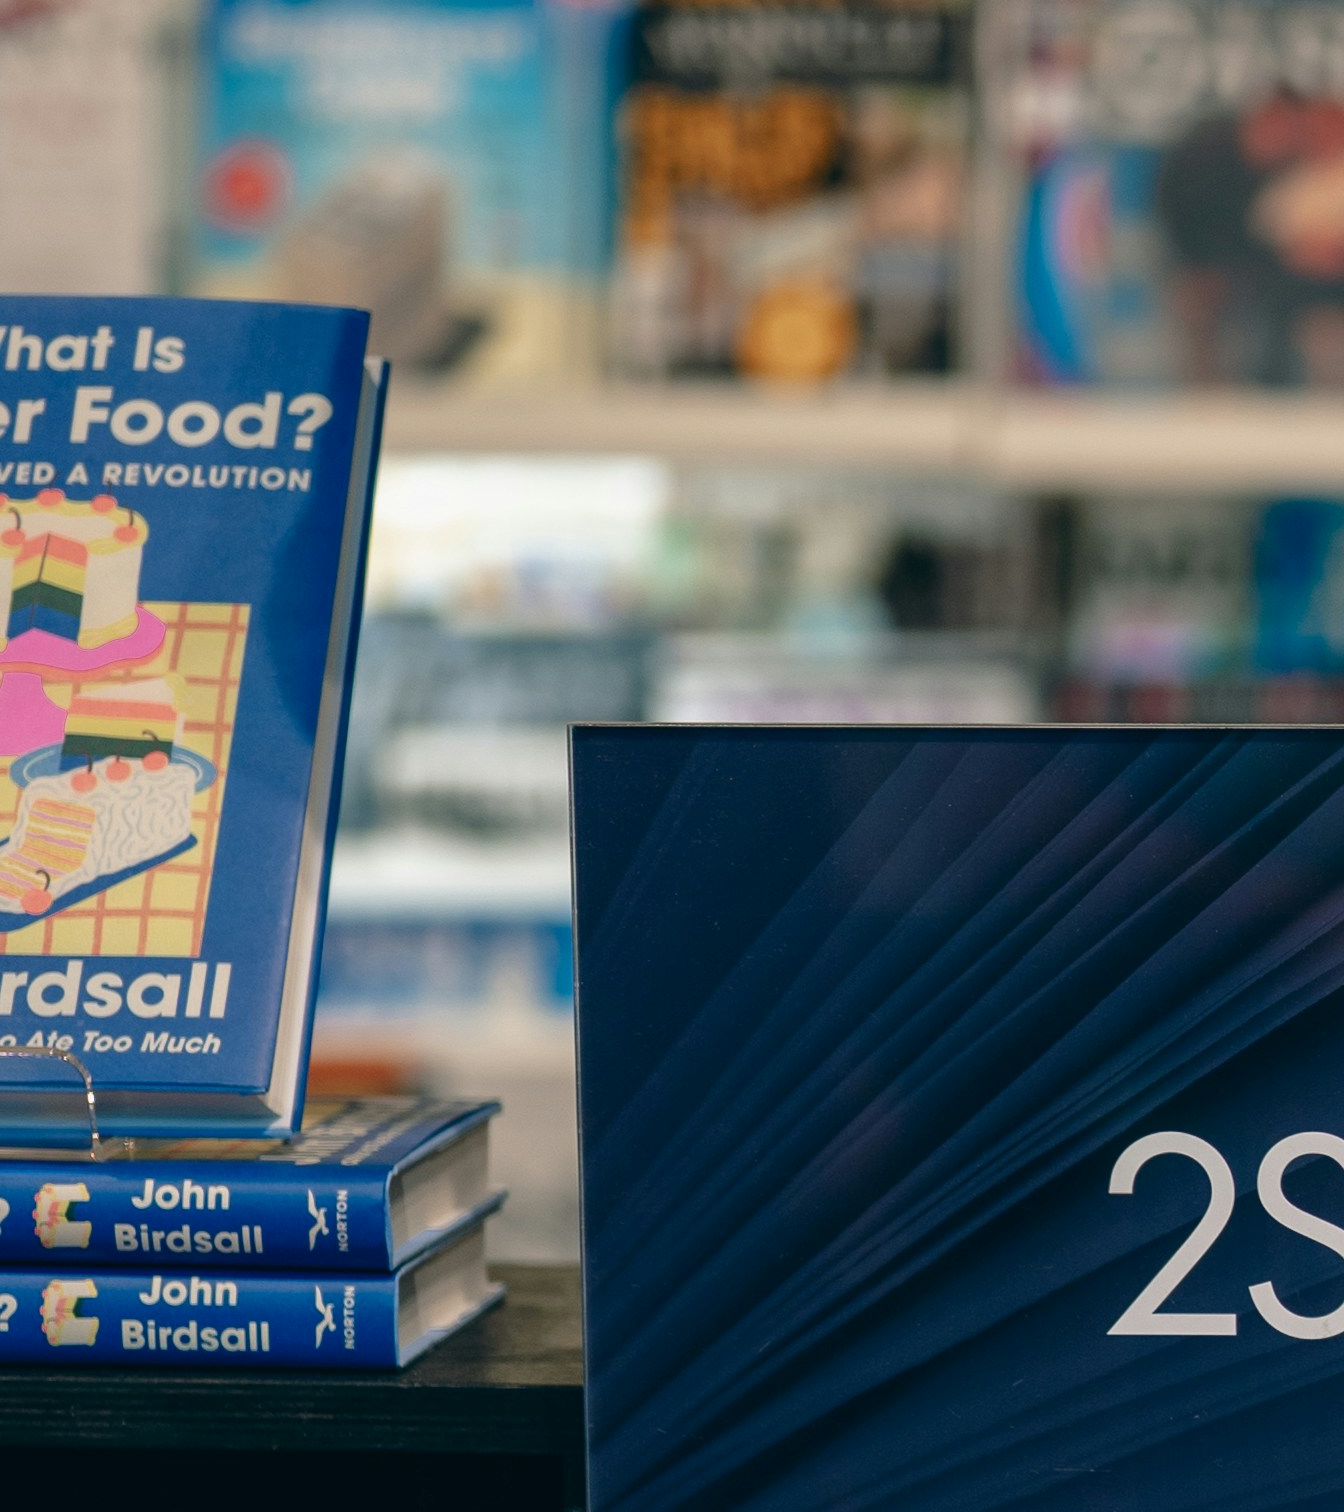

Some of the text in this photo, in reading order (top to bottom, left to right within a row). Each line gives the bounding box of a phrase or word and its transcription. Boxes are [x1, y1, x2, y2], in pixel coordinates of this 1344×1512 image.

[0, 325, 186, 373] hat Is
[69, 385, 333, 451] Food?
[66, 462, 312, 491] A REVOLUTION
[83, 1030, 133, 1053] Too
[141, 1031, 222, 1055] Much
[131, 1179, 231, 1210] John
[336, 1190, 348, 1253] NORTON
[114, 1223, 264, 1254] Birdsall
[139, 1275, 238, 1307] John
[343, 1285, 356, 1350] NORTON
[121, 1319, 270, 1352] Birdsall
